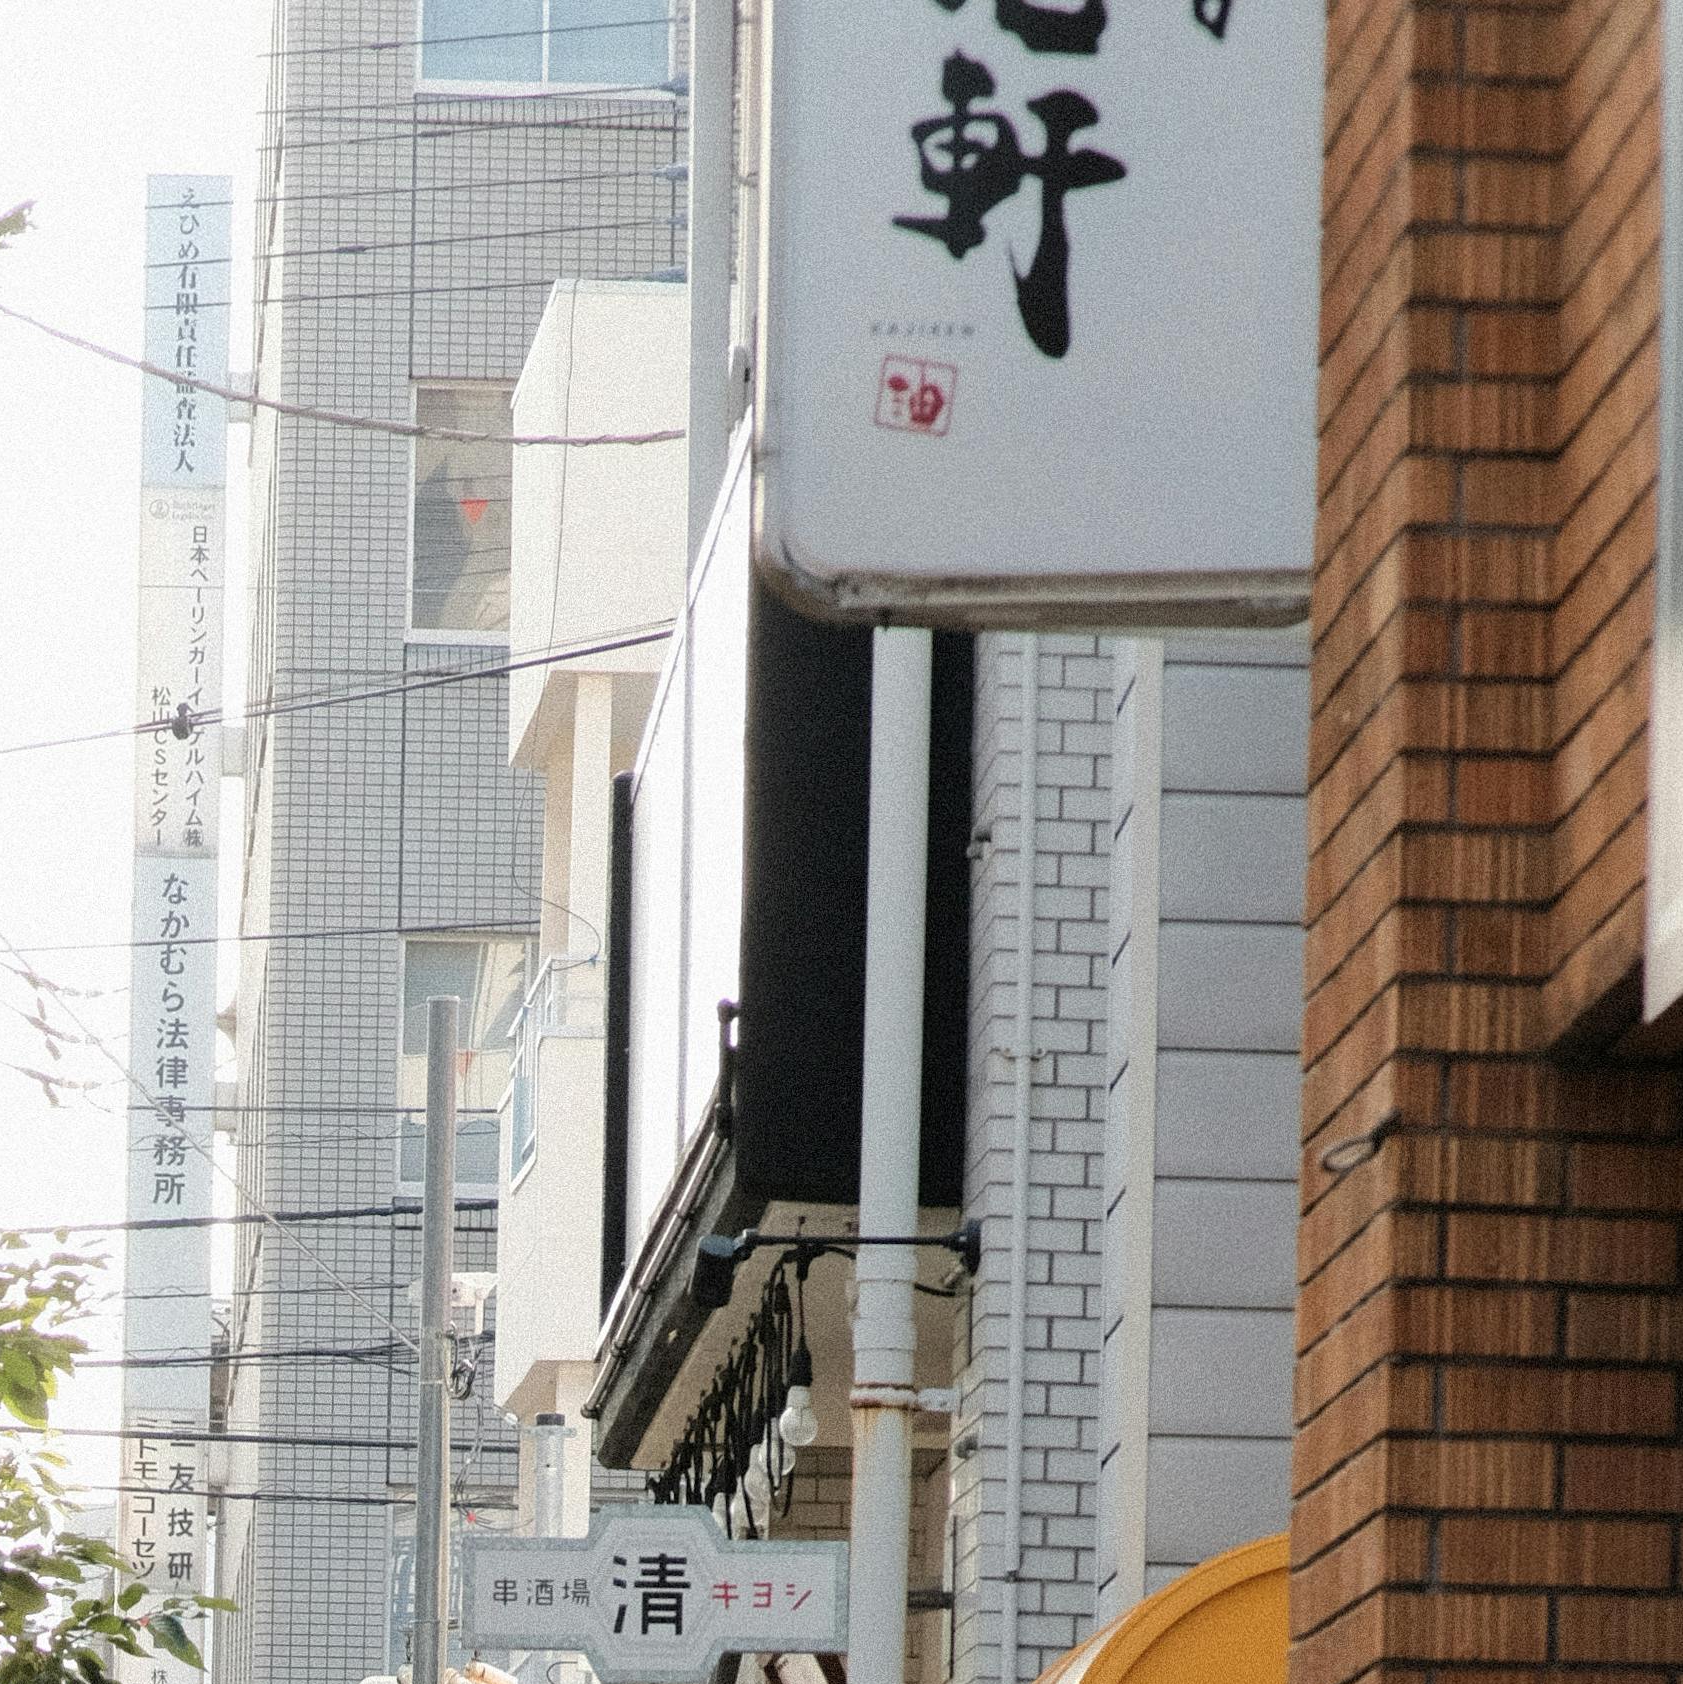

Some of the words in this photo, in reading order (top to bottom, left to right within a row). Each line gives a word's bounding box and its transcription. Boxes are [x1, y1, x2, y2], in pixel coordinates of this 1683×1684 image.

[153, 871, 191, 1207] なかむら法律事務所
[168, 1420, 195, 1581] 三友技研
[493, 1578, 591, 1608] 串酒場
[612, 1553, 691, 1636] 清
[711, 1579, 813, 1611] キヨシ
